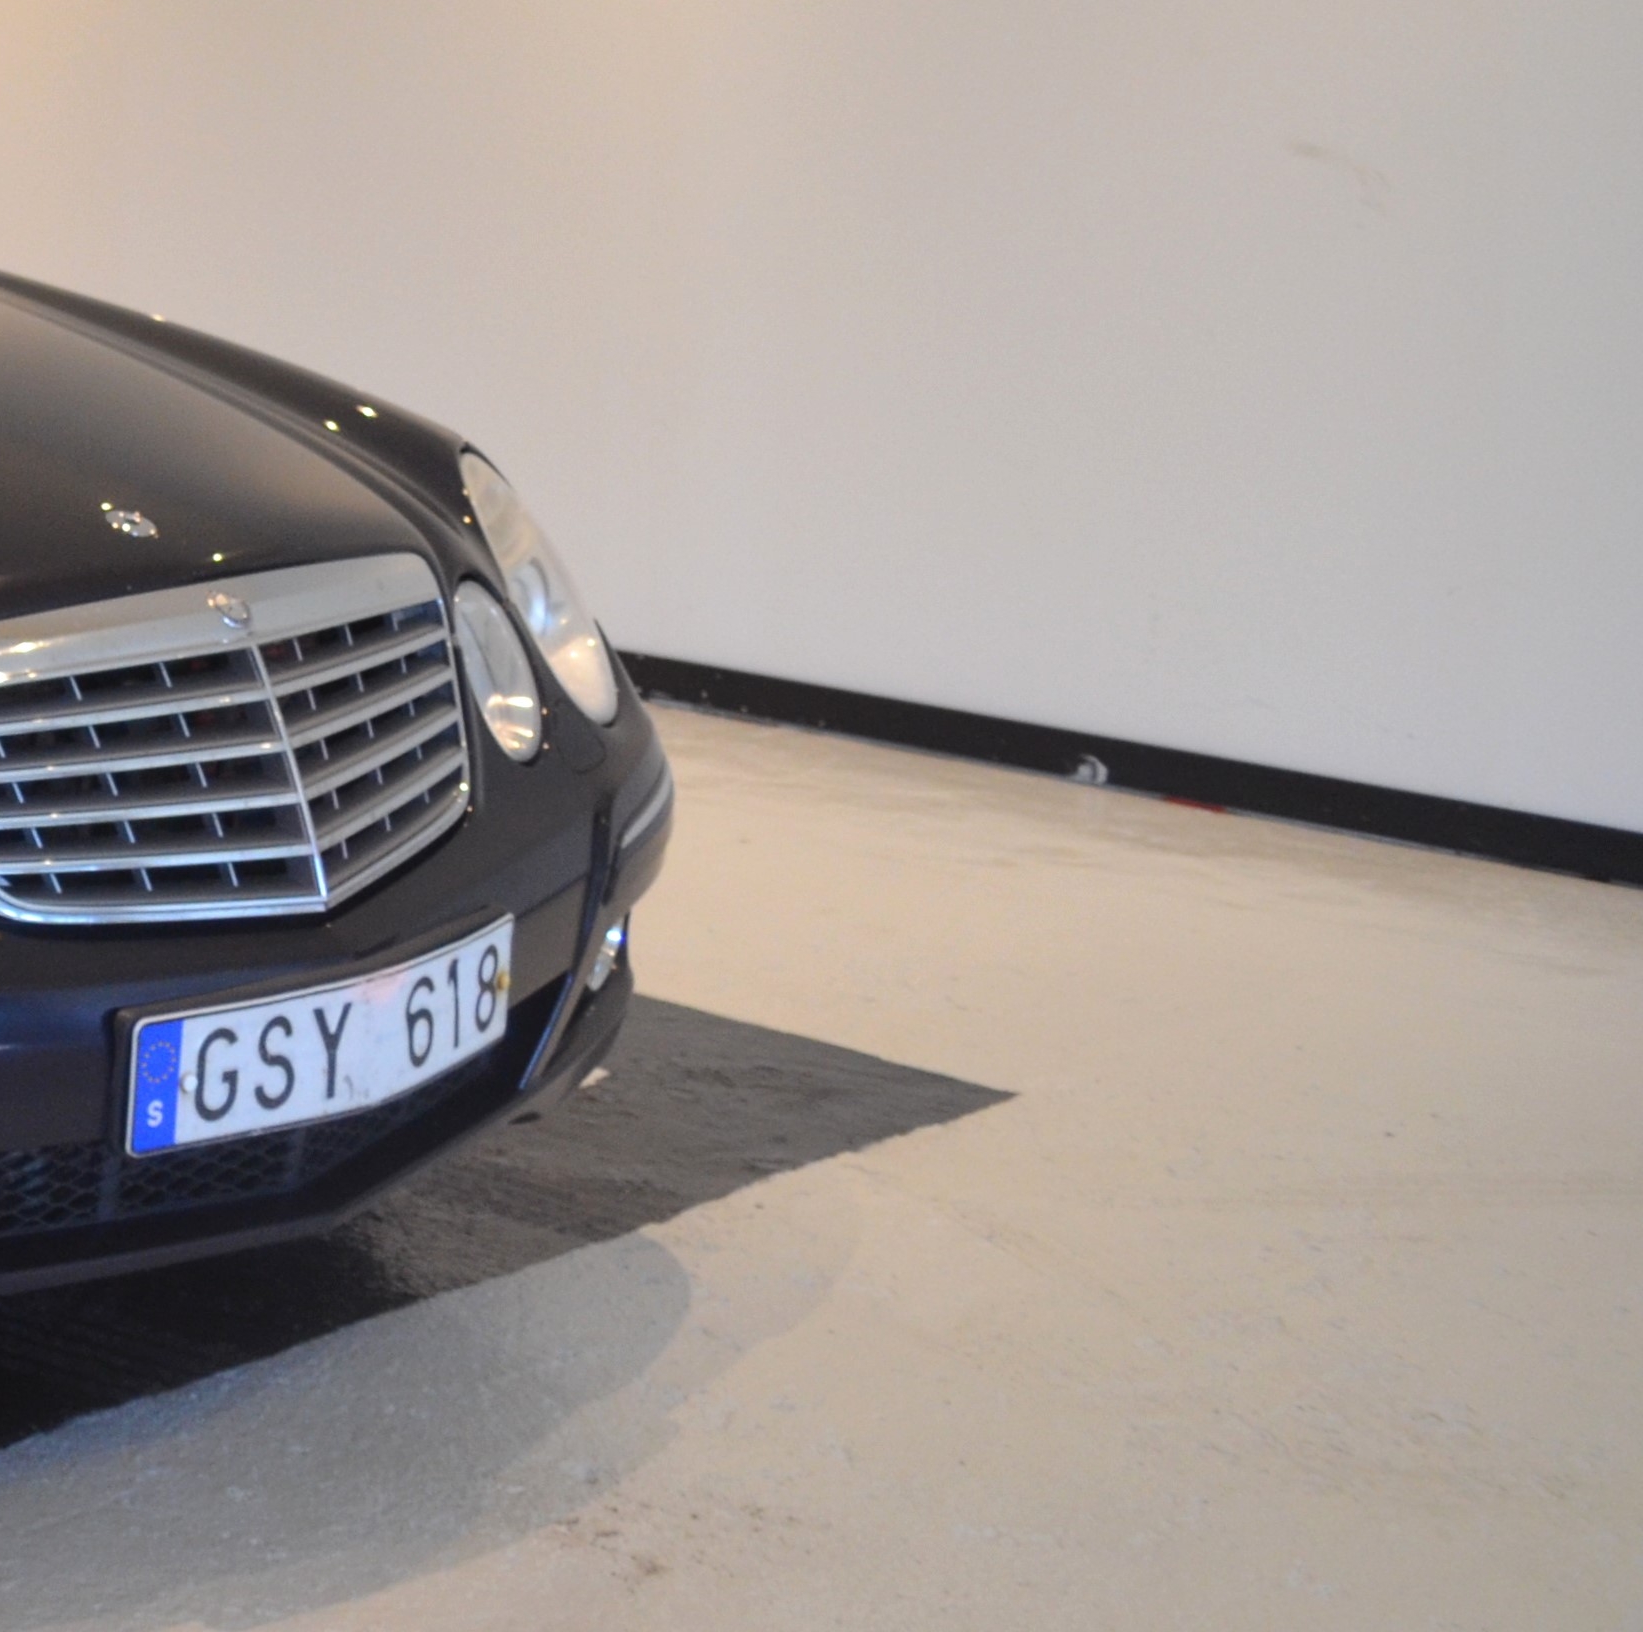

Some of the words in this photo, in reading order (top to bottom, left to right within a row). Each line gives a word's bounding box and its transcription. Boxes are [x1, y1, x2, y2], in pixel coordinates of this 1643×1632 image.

[194, 1002, 352, 1122] GSY
[405, 944, 499, 1067] 618
[146, 1100, 164, 1128] S
